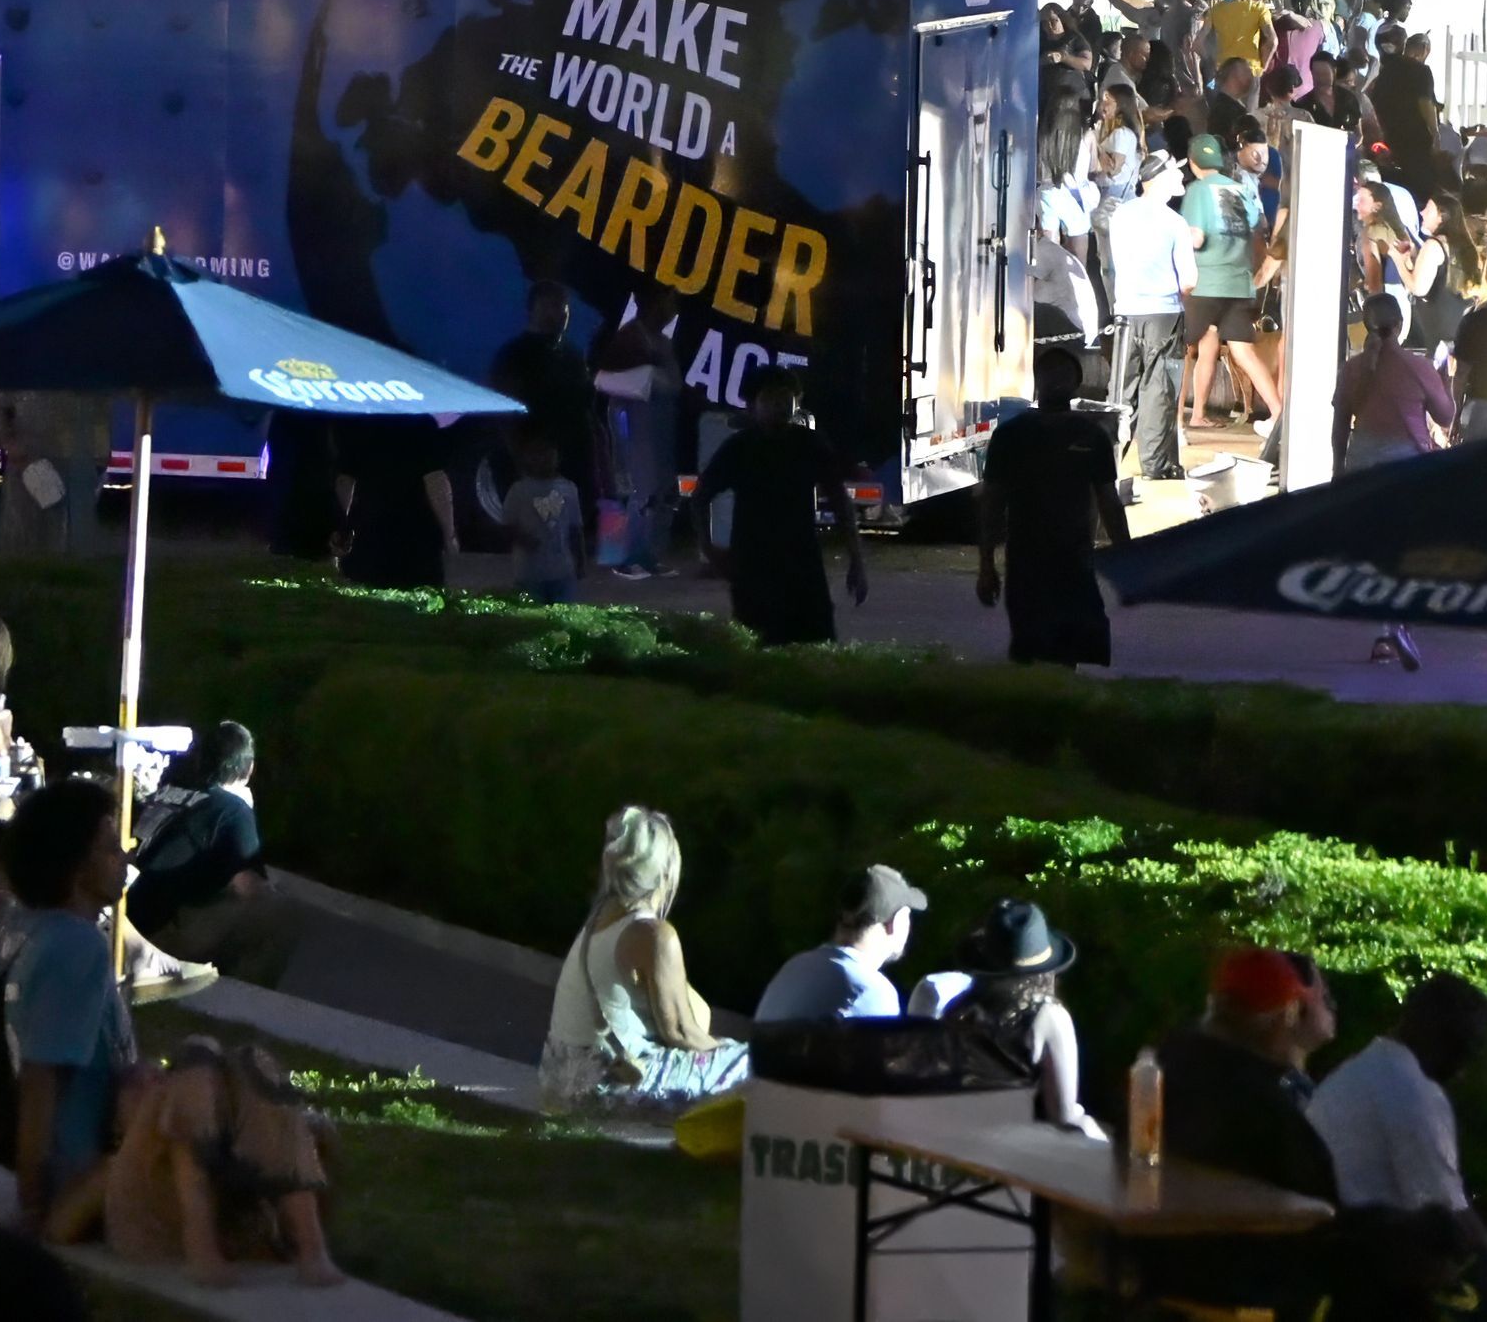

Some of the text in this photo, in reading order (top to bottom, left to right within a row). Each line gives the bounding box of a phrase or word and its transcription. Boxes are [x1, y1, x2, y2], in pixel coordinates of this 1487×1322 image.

[499, 52, 735, 159] THE WORLD A
[457, 97, 829, 338] BEARDER
[248, 368, 424, 408] Corona
